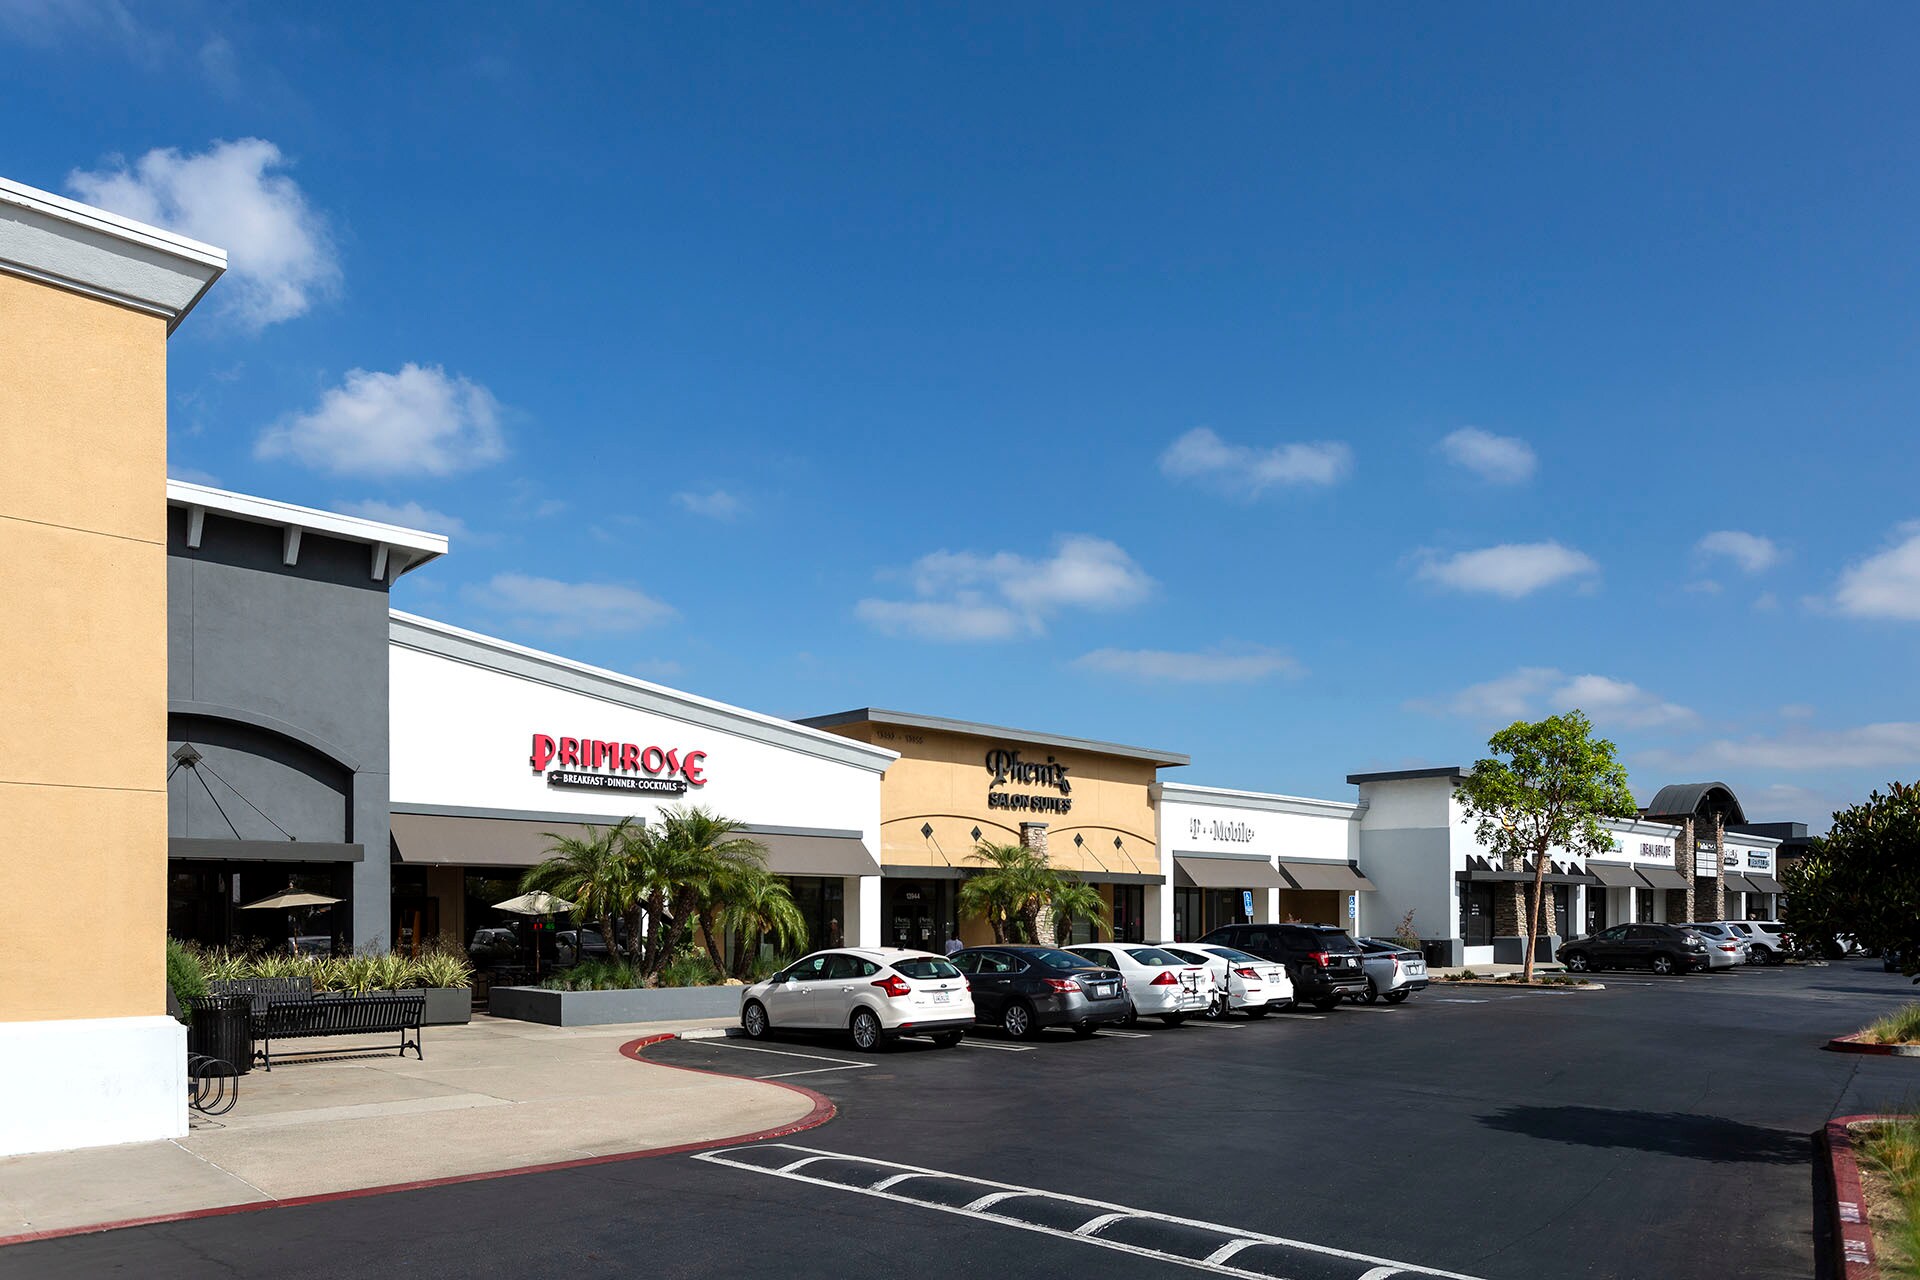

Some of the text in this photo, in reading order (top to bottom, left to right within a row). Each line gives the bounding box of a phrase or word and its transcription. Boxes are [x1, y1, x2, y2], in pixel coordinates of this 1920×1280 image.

[530, 733, 708, 785] PRIMROSE
[985, 749, 1072, 794] Phenix
[562, 773, 678, 792] BREAKFAST DINNER COCKTAILS
[988, 792, 1072, 813] SALON SUITES
